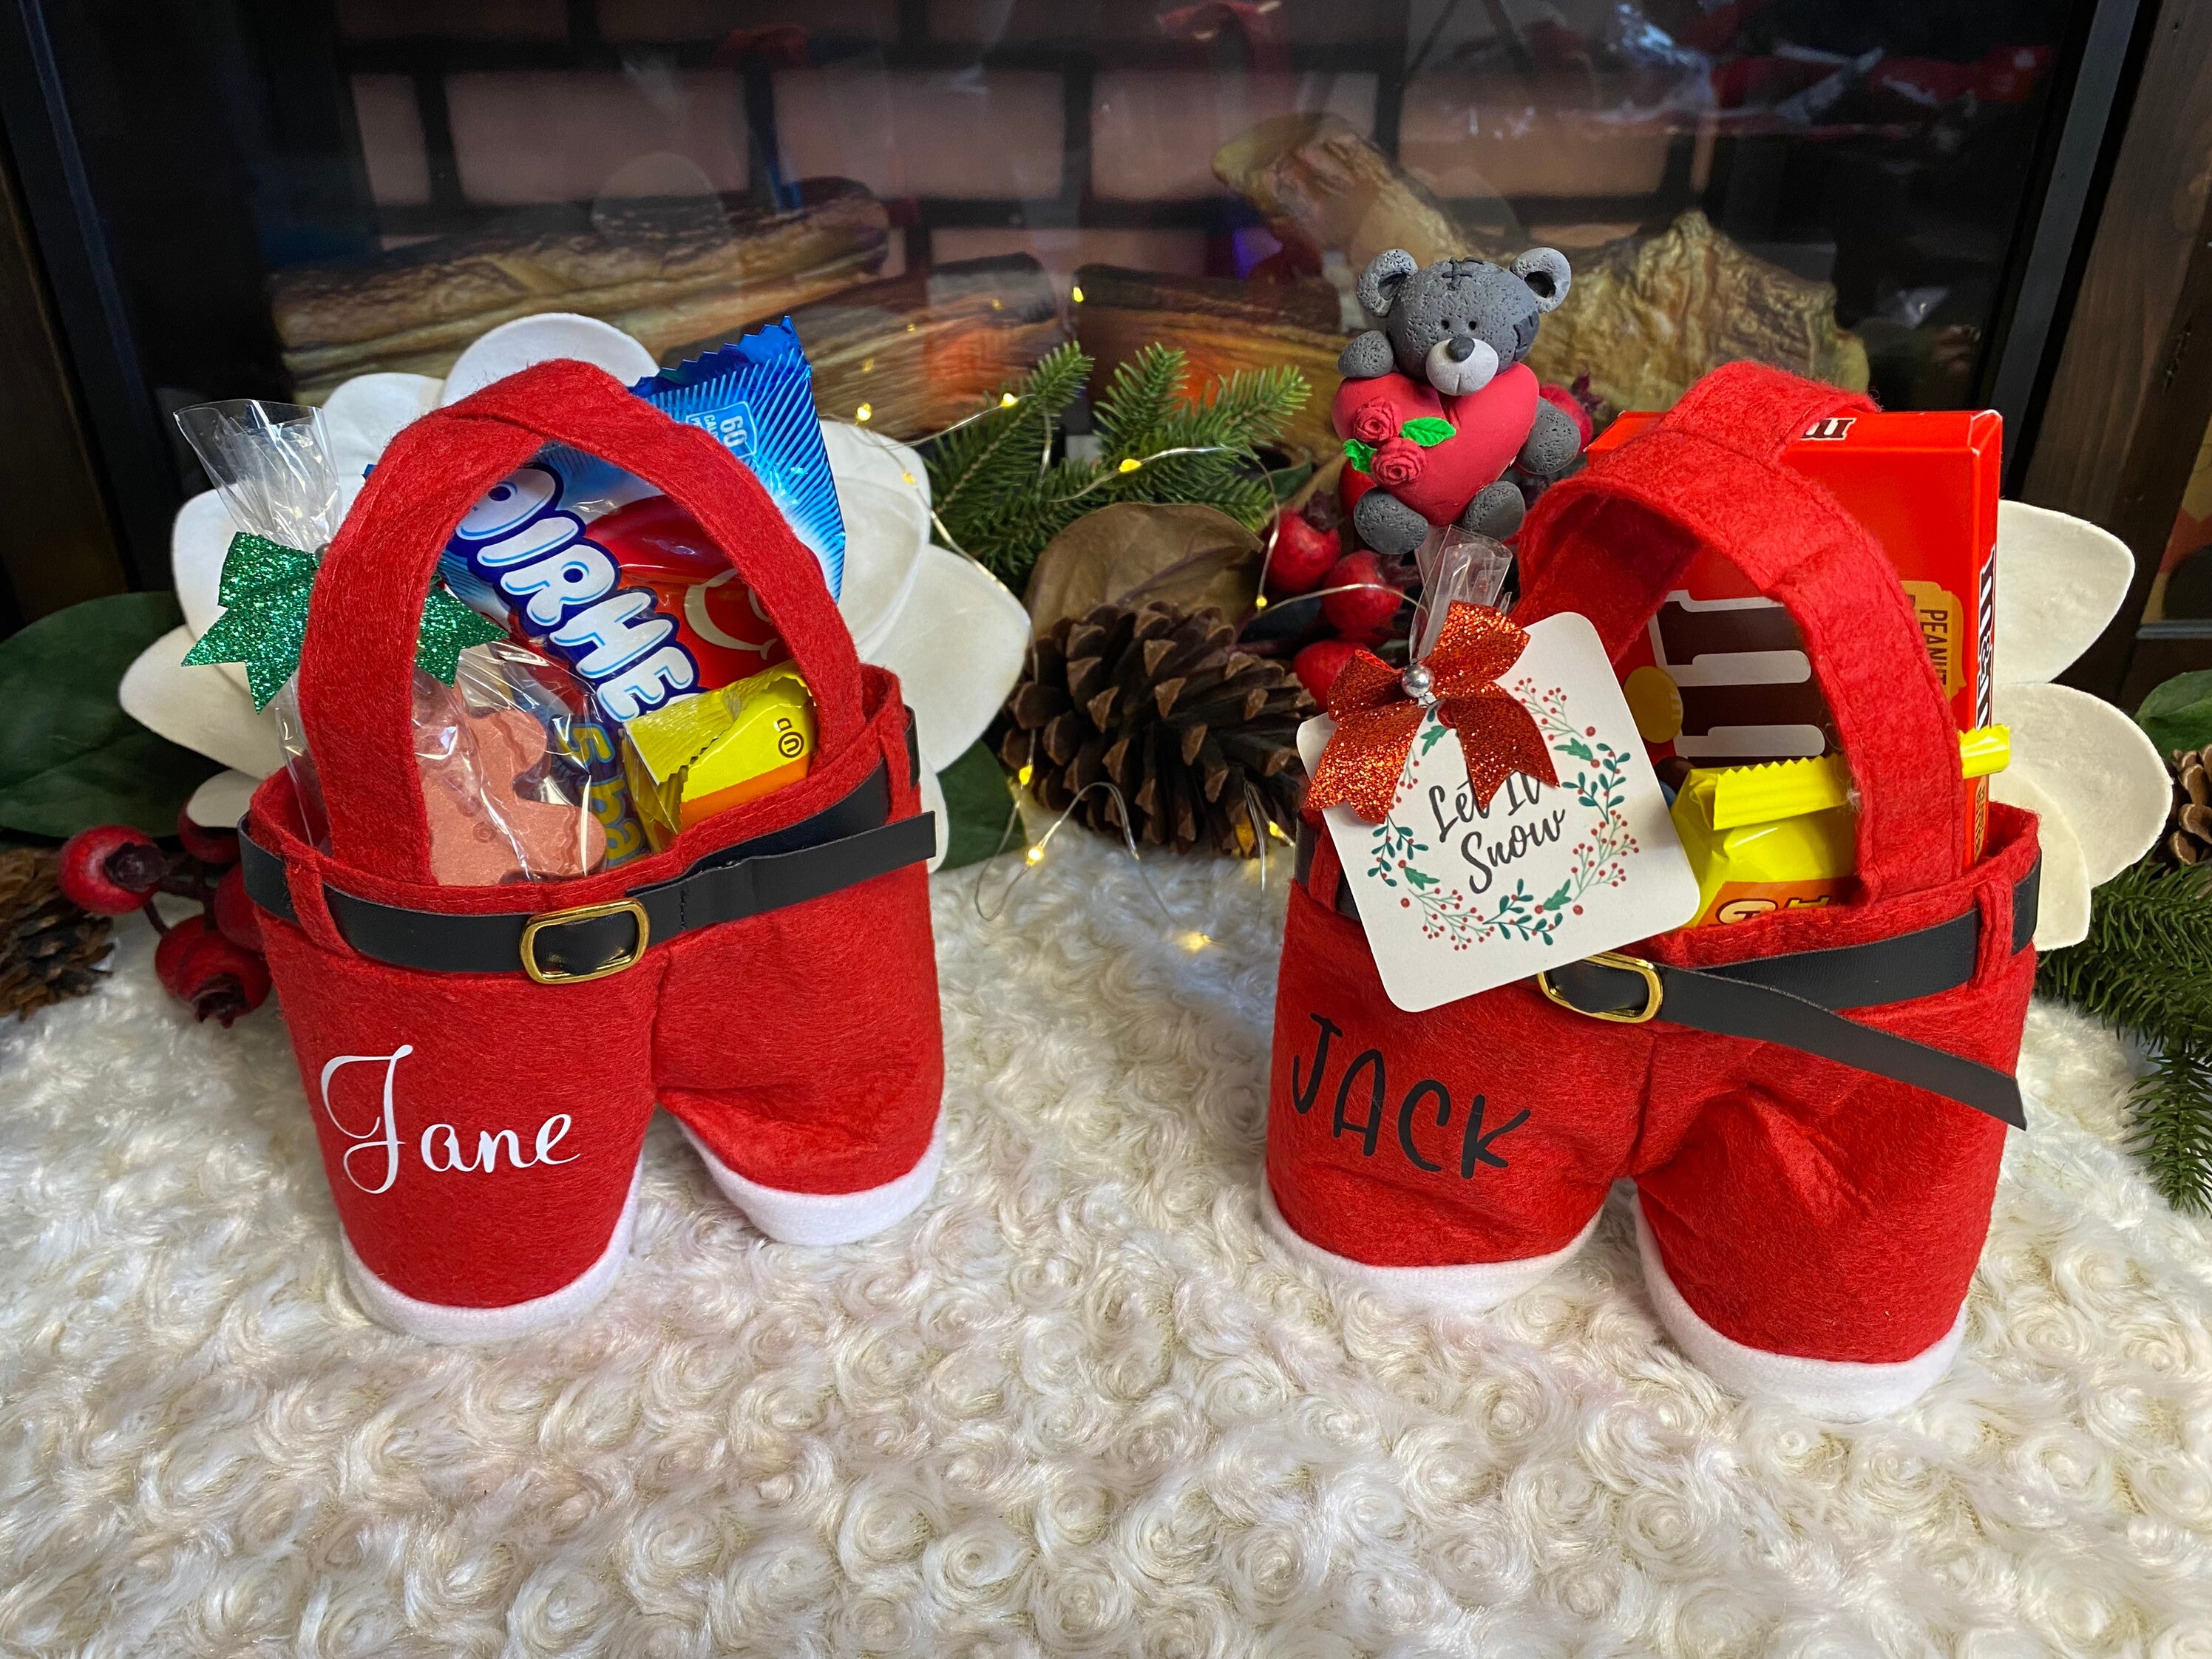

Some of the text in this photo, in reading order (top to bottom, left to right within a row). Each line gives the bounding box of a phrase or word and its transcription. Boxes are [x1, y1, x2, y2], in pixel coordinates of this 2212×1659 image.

[720, 415, 747, 447] 60
[447, 467, 699, 722] AIRHE
[575, 775, 642, 864] ba
[1461, 809, 1566, 894] Snow
[321, 1044, 580, 1194] Jane
[1292, 1012, 1531, 1179] JACK
